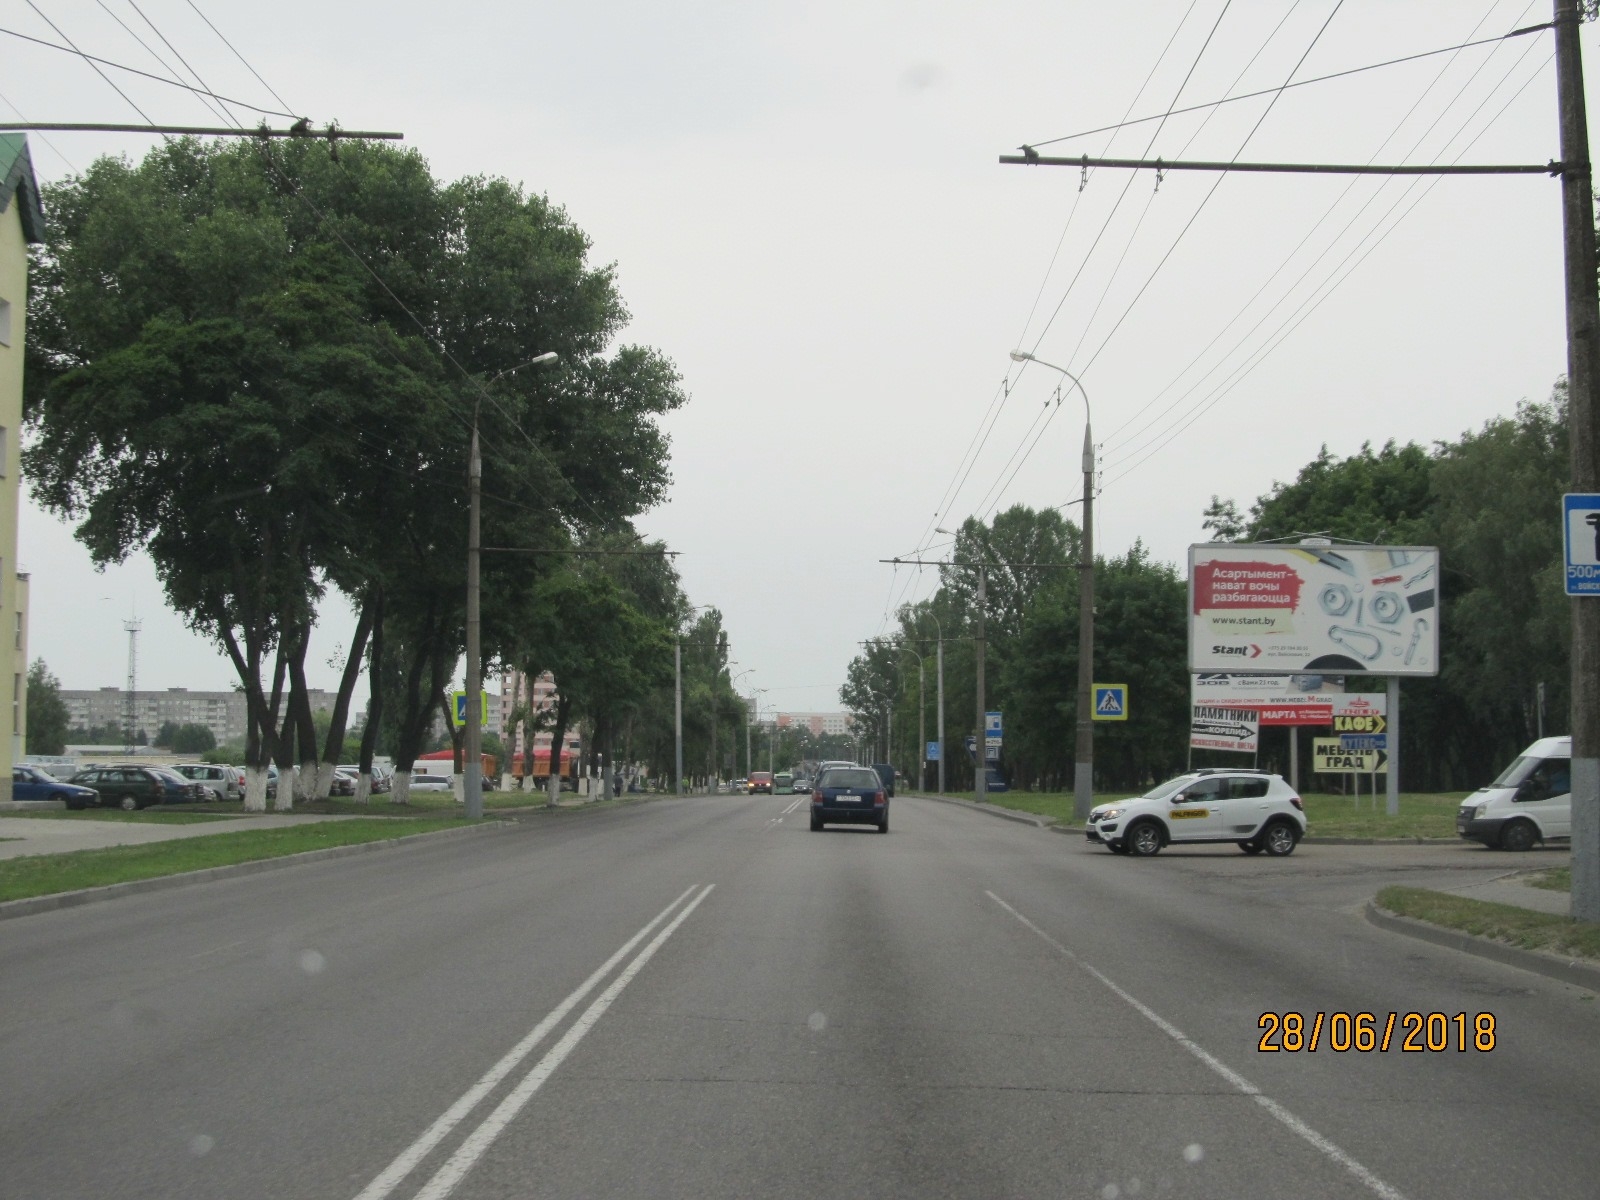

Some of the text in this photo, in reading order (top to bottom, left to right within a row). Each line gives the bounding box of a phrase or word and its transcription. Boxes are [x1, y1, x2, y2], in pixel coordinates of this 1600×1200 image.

[1212, 581, 1280, 591] нават вочы
[1212, 592, 1291, 604] разбягаюцца
[1212, 616, 1276, 626] www.stant.by
[1212, 645, 1249, 656] Stant
[1194, 706, 1256, 722] ПАМЯТНИКИ
[1262, 710, 1297, 719] МАРТА
[1334, 716, 1373, 731] КАФЕ
[1327, 756, 1364, 769] ГРАД
